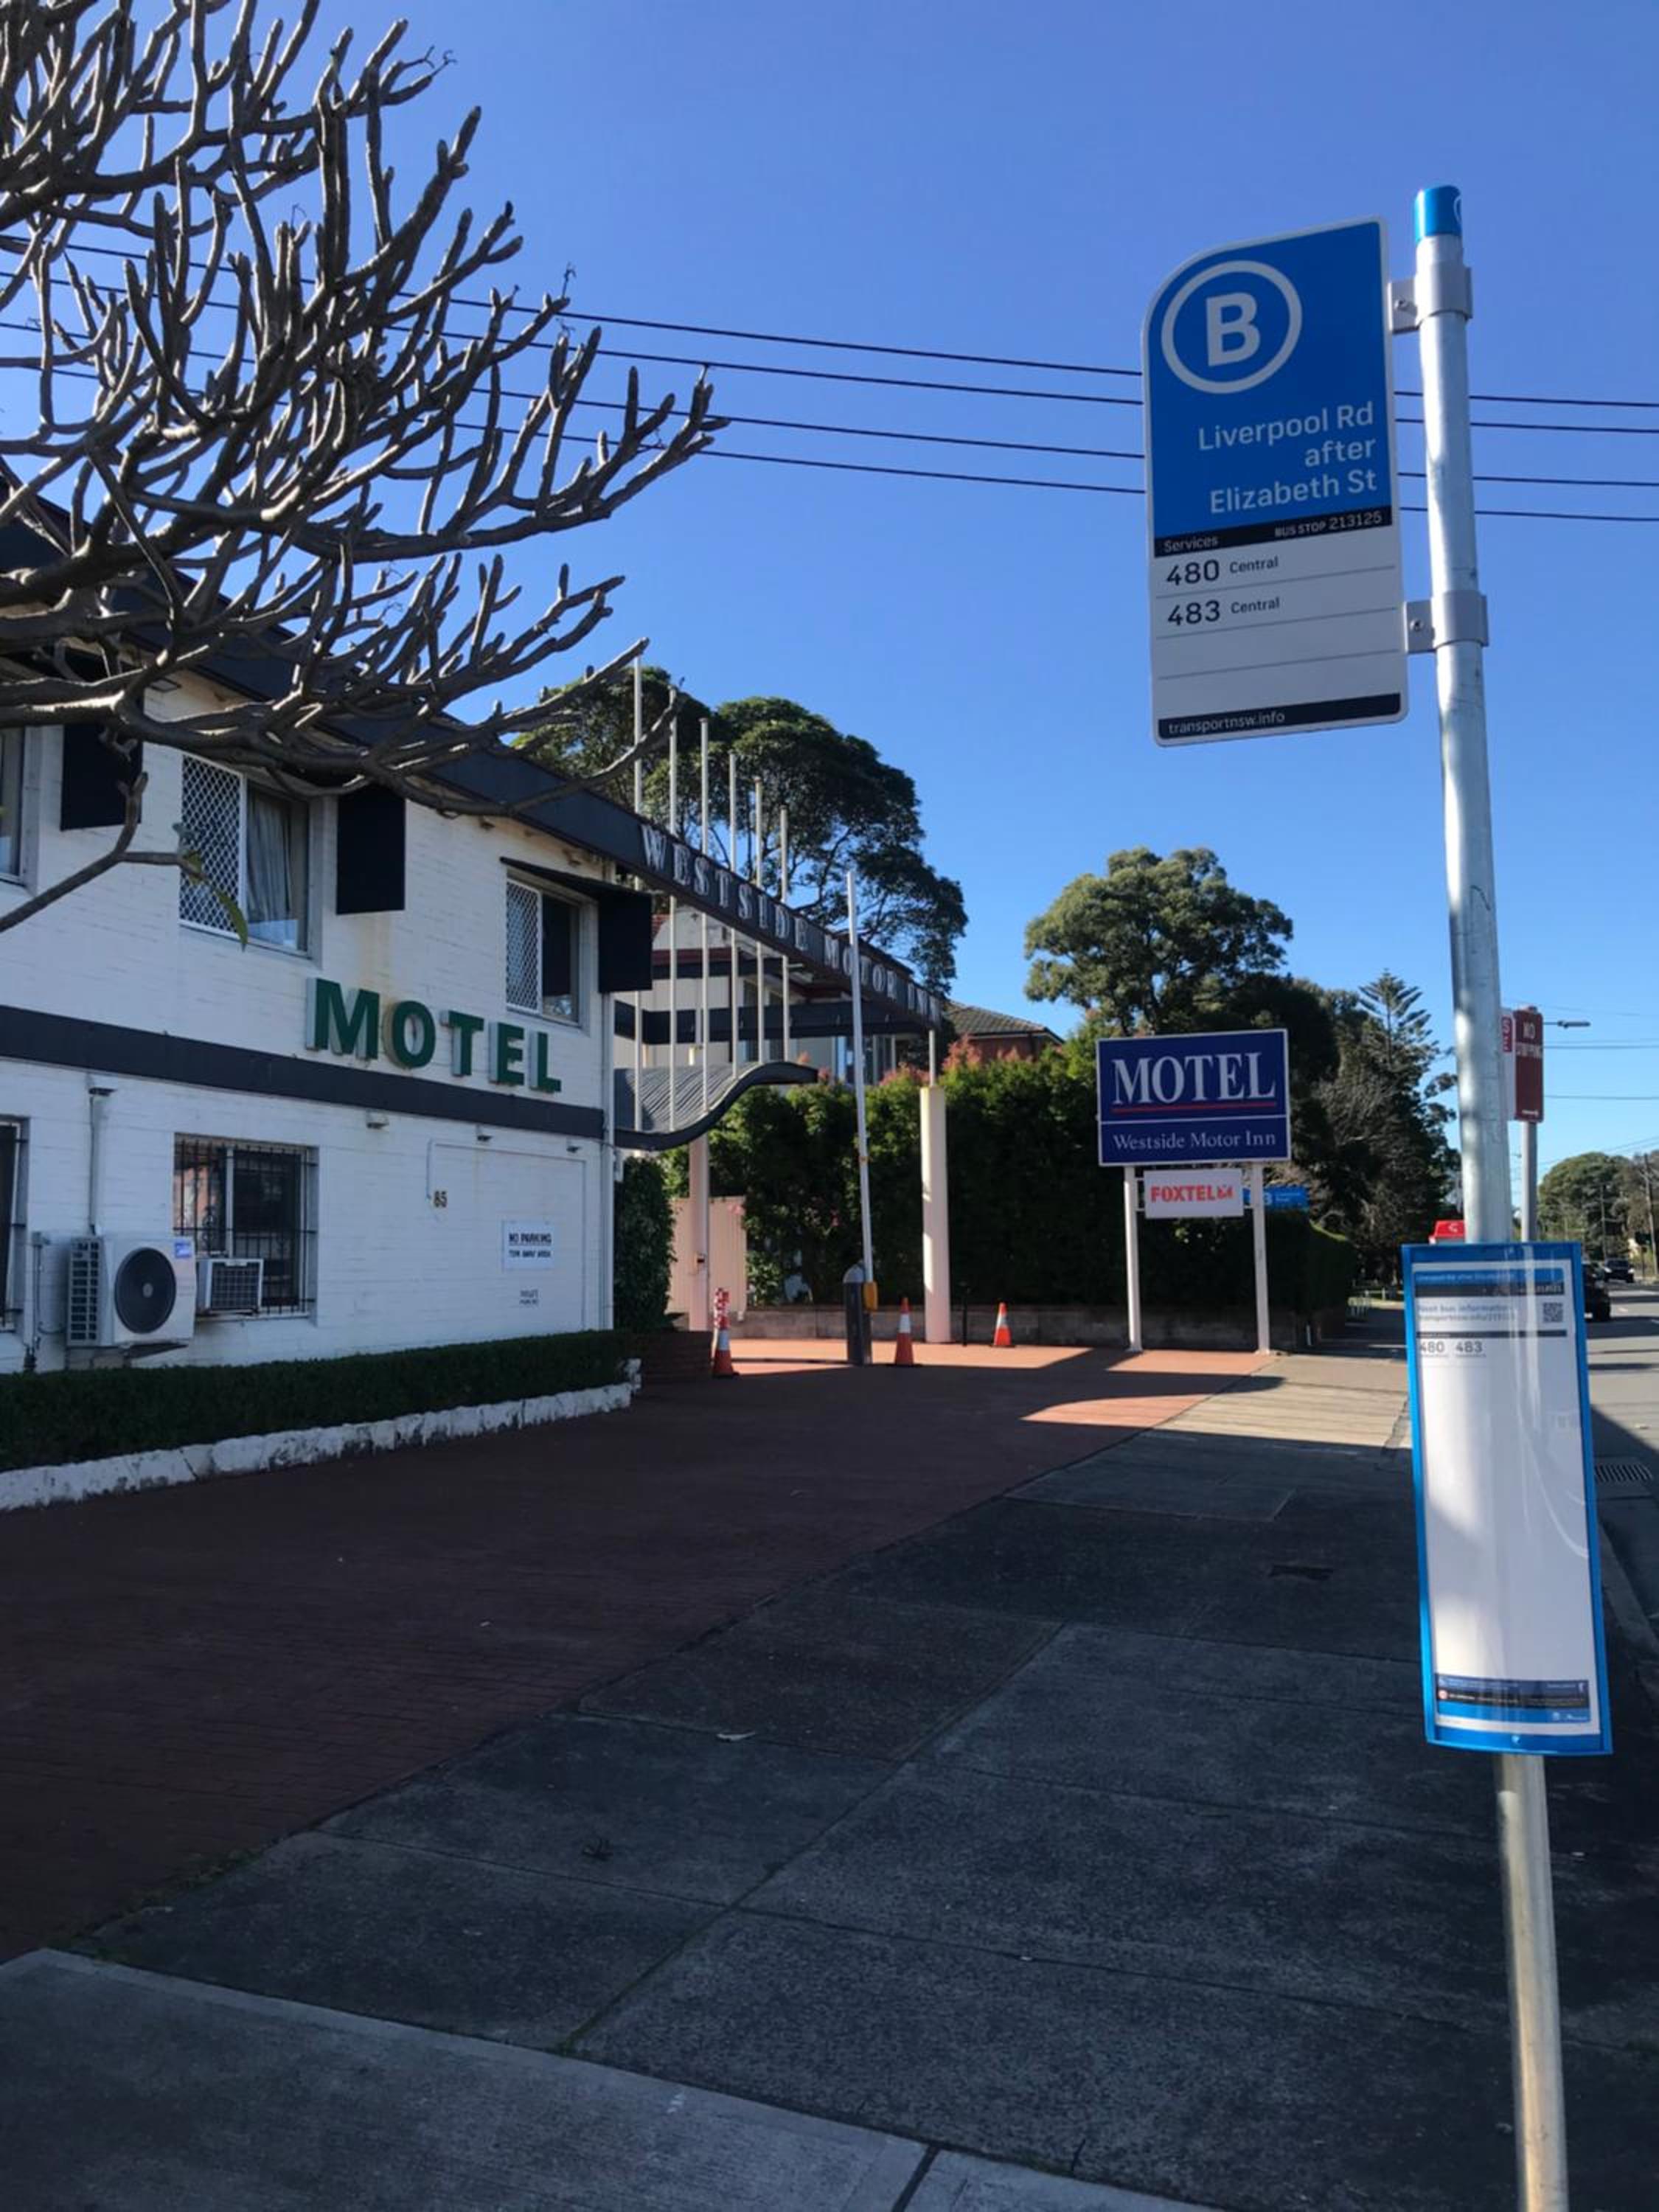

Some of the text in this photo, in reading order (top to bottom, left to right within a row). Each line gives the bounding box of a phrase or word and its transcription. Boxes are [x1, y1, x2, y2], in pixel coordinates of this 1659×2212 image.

[1206, 292, 1261, 367] B
[1197, 401, 1374, 451] Liverpool Rd
[1304, 438, 1377, 467] after
[1210, 469, 1378, 514] Elizabeth St
[1275, 510, 1383, 538] BUS STOP 213125
[1164, 535, 1219, 553] Services
[1166, 556, 1279, 586] 480 Central
[1167, 597, 1281, 626] 483 Central
[1169, 710, 1286, 734] transportnsw.info
[641, 823, 809, 951] WESTSIDE
[306, 978, 562, 1093] MOTEL
[1111, 1051, 1276, 1105] MOTEL
[1113, 1130, 1276, 1150] Westside Motor Inn
[1151, 1183, 1215, 1203] FOXTEL
[509, 1233, 518, 1245] NO
[1420, 1340, 1483, 1352] 480 483
